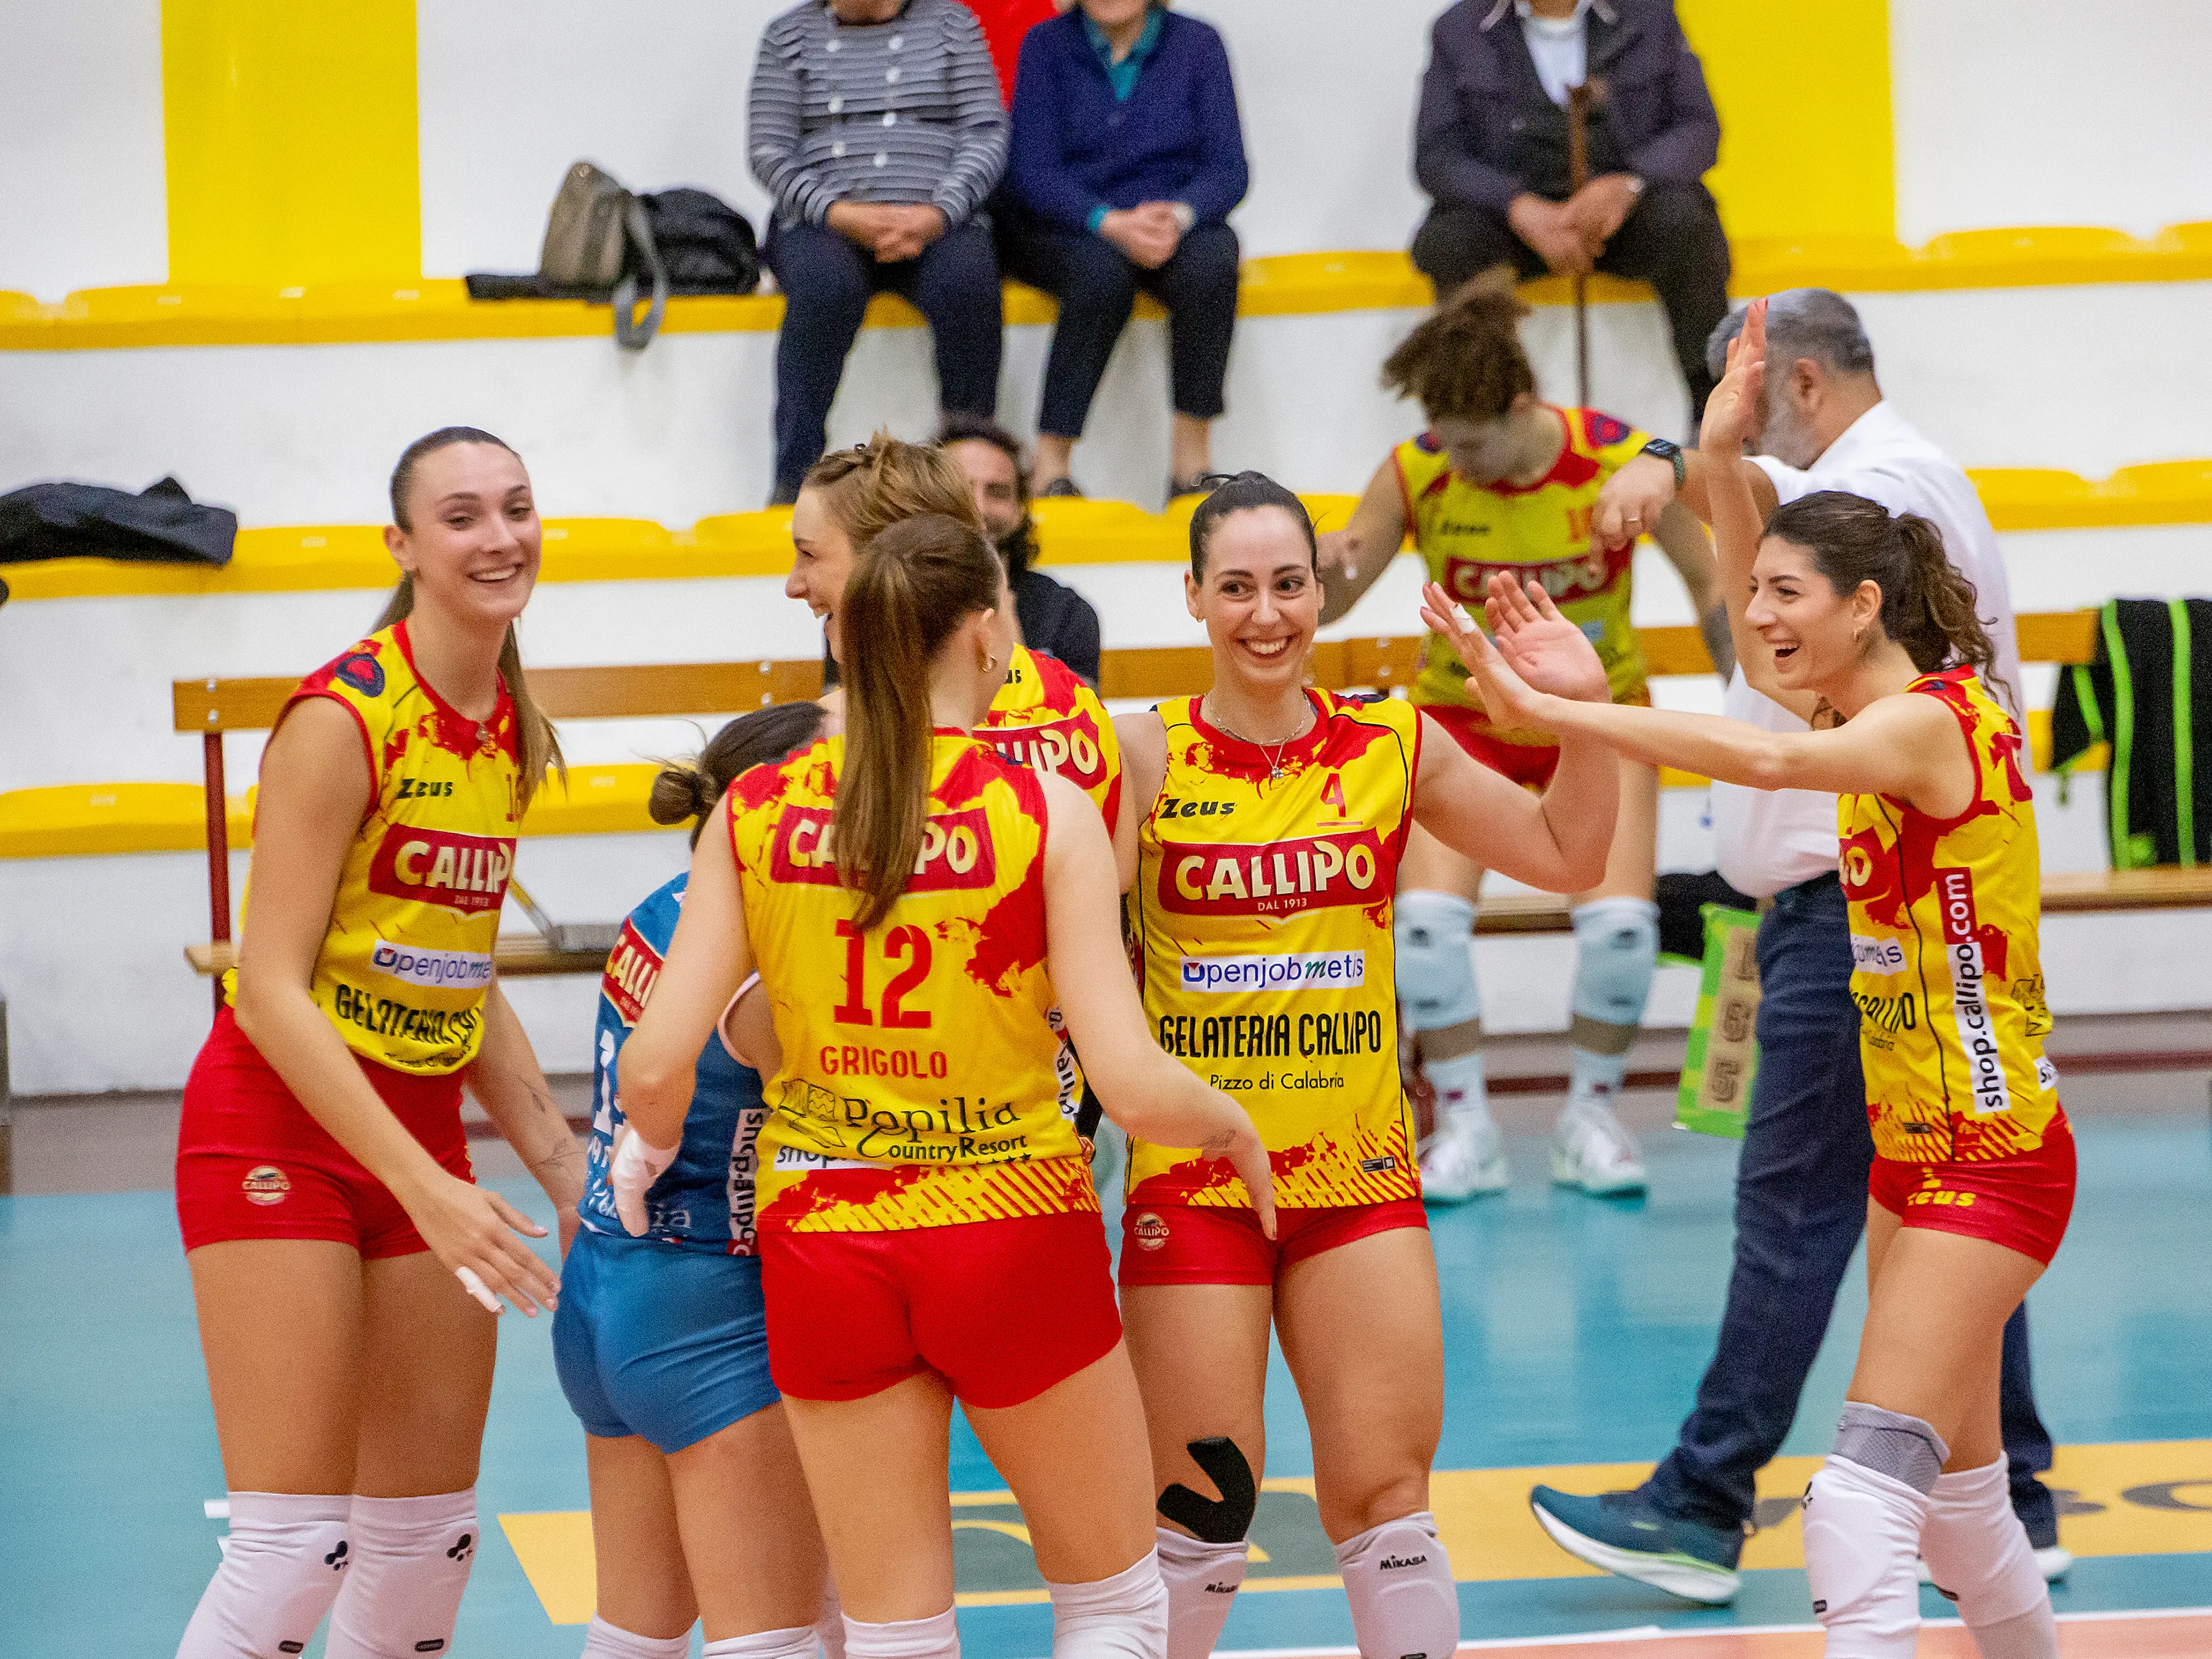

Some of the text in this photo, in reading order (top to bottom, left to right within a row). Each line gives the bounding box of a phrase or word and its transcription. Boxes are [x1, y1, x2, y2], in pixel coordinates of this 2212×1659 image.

[396, 778, 453, 800] Zeus
[1159, 798, 1236, 819] Zeus
[788, 819, 978, 875] CAPO
[1176, 840, 1376, 901] CALLIPO
[1257, 898, 1307, 911] DAL 1913
[833, 919, 932, 1029] 12
[1183, 954, 1364, 988] Openjobmetis
[1945, 873, 2003, 1108] shop.callipo.com
[1159, 1013, 1290, 1058] GELATERIA
[820, 1045, 948, 1079] GRIGOLO
[1210, 1071, 1344, 1090] Pizzo di Calabria
[840, 1096, 1021, 1143] Popilia
